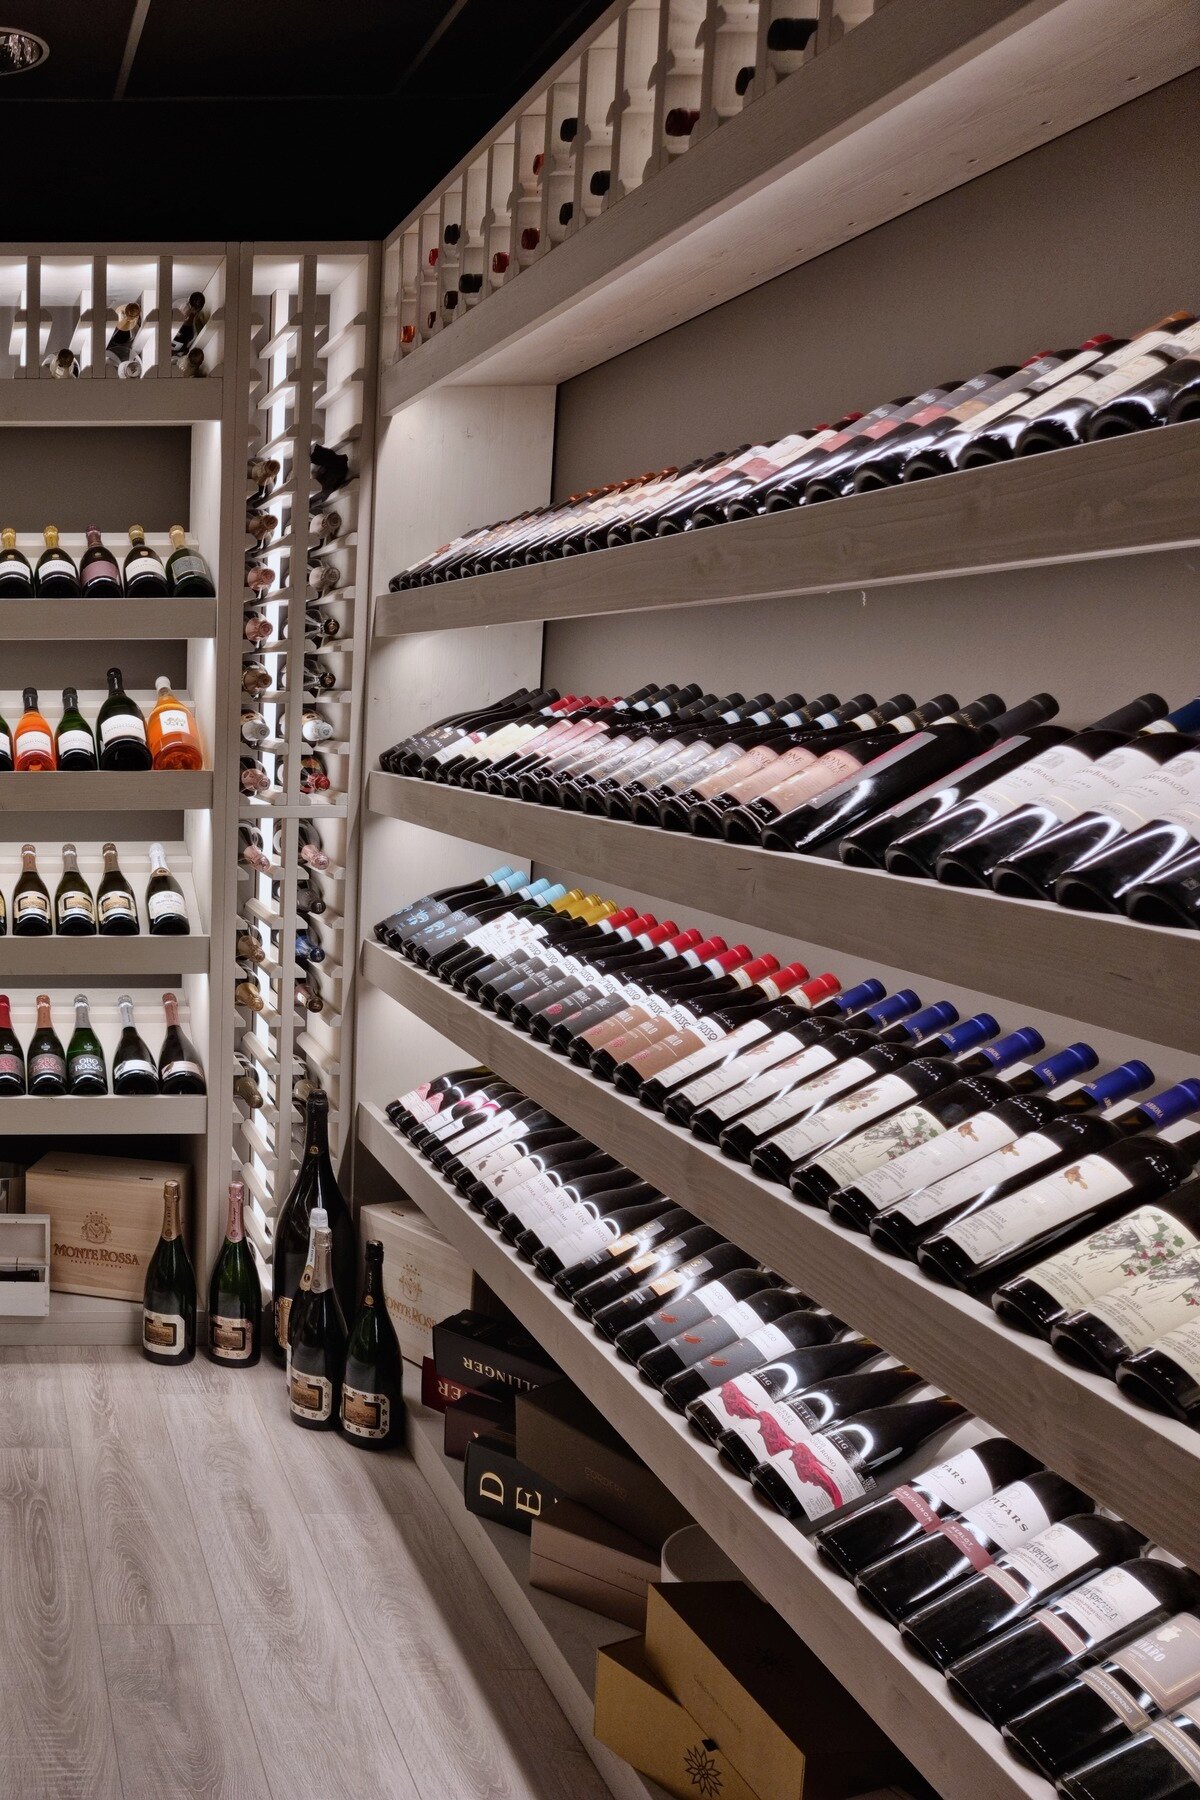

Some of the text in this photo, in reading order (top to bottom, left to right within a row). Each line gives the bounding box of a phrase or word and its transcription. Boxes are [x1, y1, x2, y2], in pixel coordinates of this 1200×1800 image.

[75, 1063, 102, 1072] ROSSO
[463, 1357, 539, 1391] LLINGER
[942, 1464, 967, 1485] TARS
[951, 1525, 974, 1547] MERLOT
